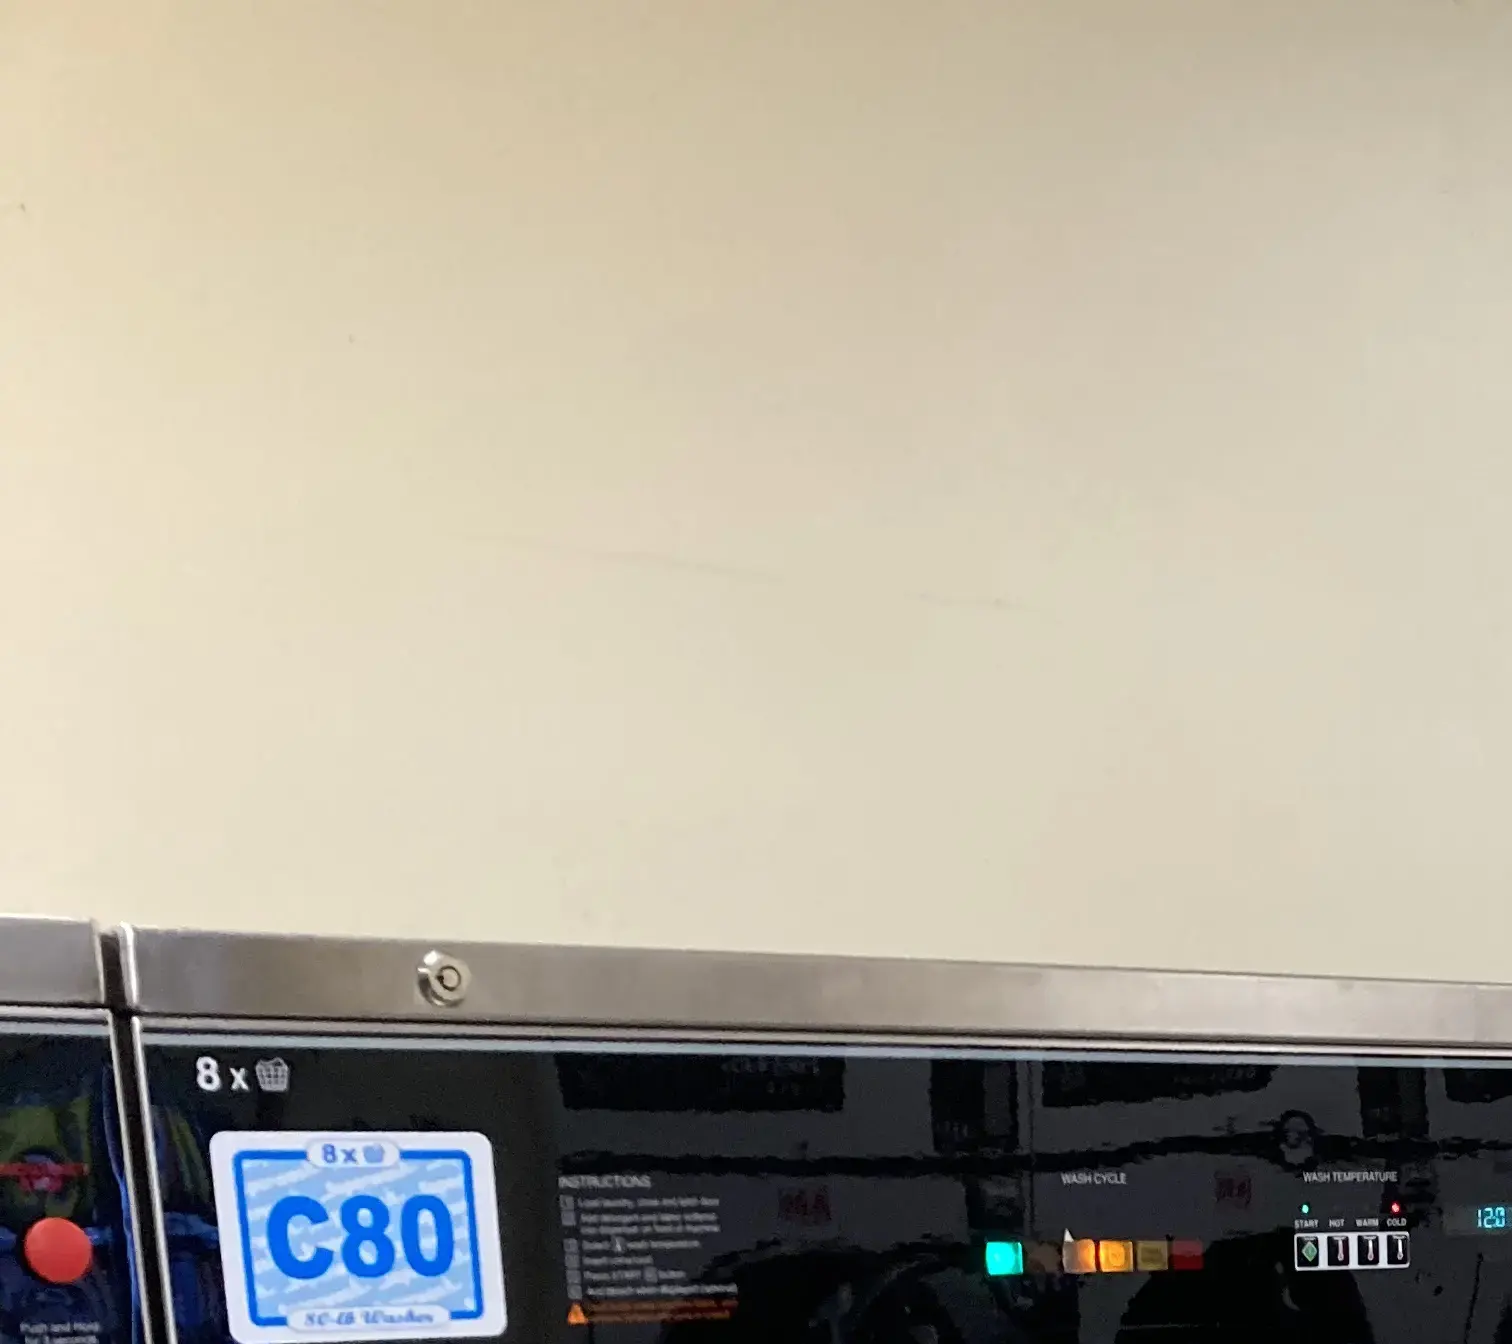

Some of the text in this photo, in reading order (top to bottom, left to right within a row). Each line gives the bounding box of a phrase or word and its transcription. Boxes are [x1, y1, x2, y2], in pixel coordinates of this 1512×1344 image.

[196, 1056, 249, 1092] 8 x
[322, 1143, 357, 1165] 8 x
[558, 1174, 651, 1189] INSTRUCTIONS
[1061, 1172, 1127, 1185] WASH CYCLE
[1303, 1171, 1398, 1183] WASH TEMPERATURE
[1294, 1219, 1319, 1229] START
[1329, 1219, 1345, 1228] HOT
[1355, 1218, 1379, 1227] WARM
[1386, 1218, 1407, 1227] COLD
[266, 1194, 455, 1280] C80
